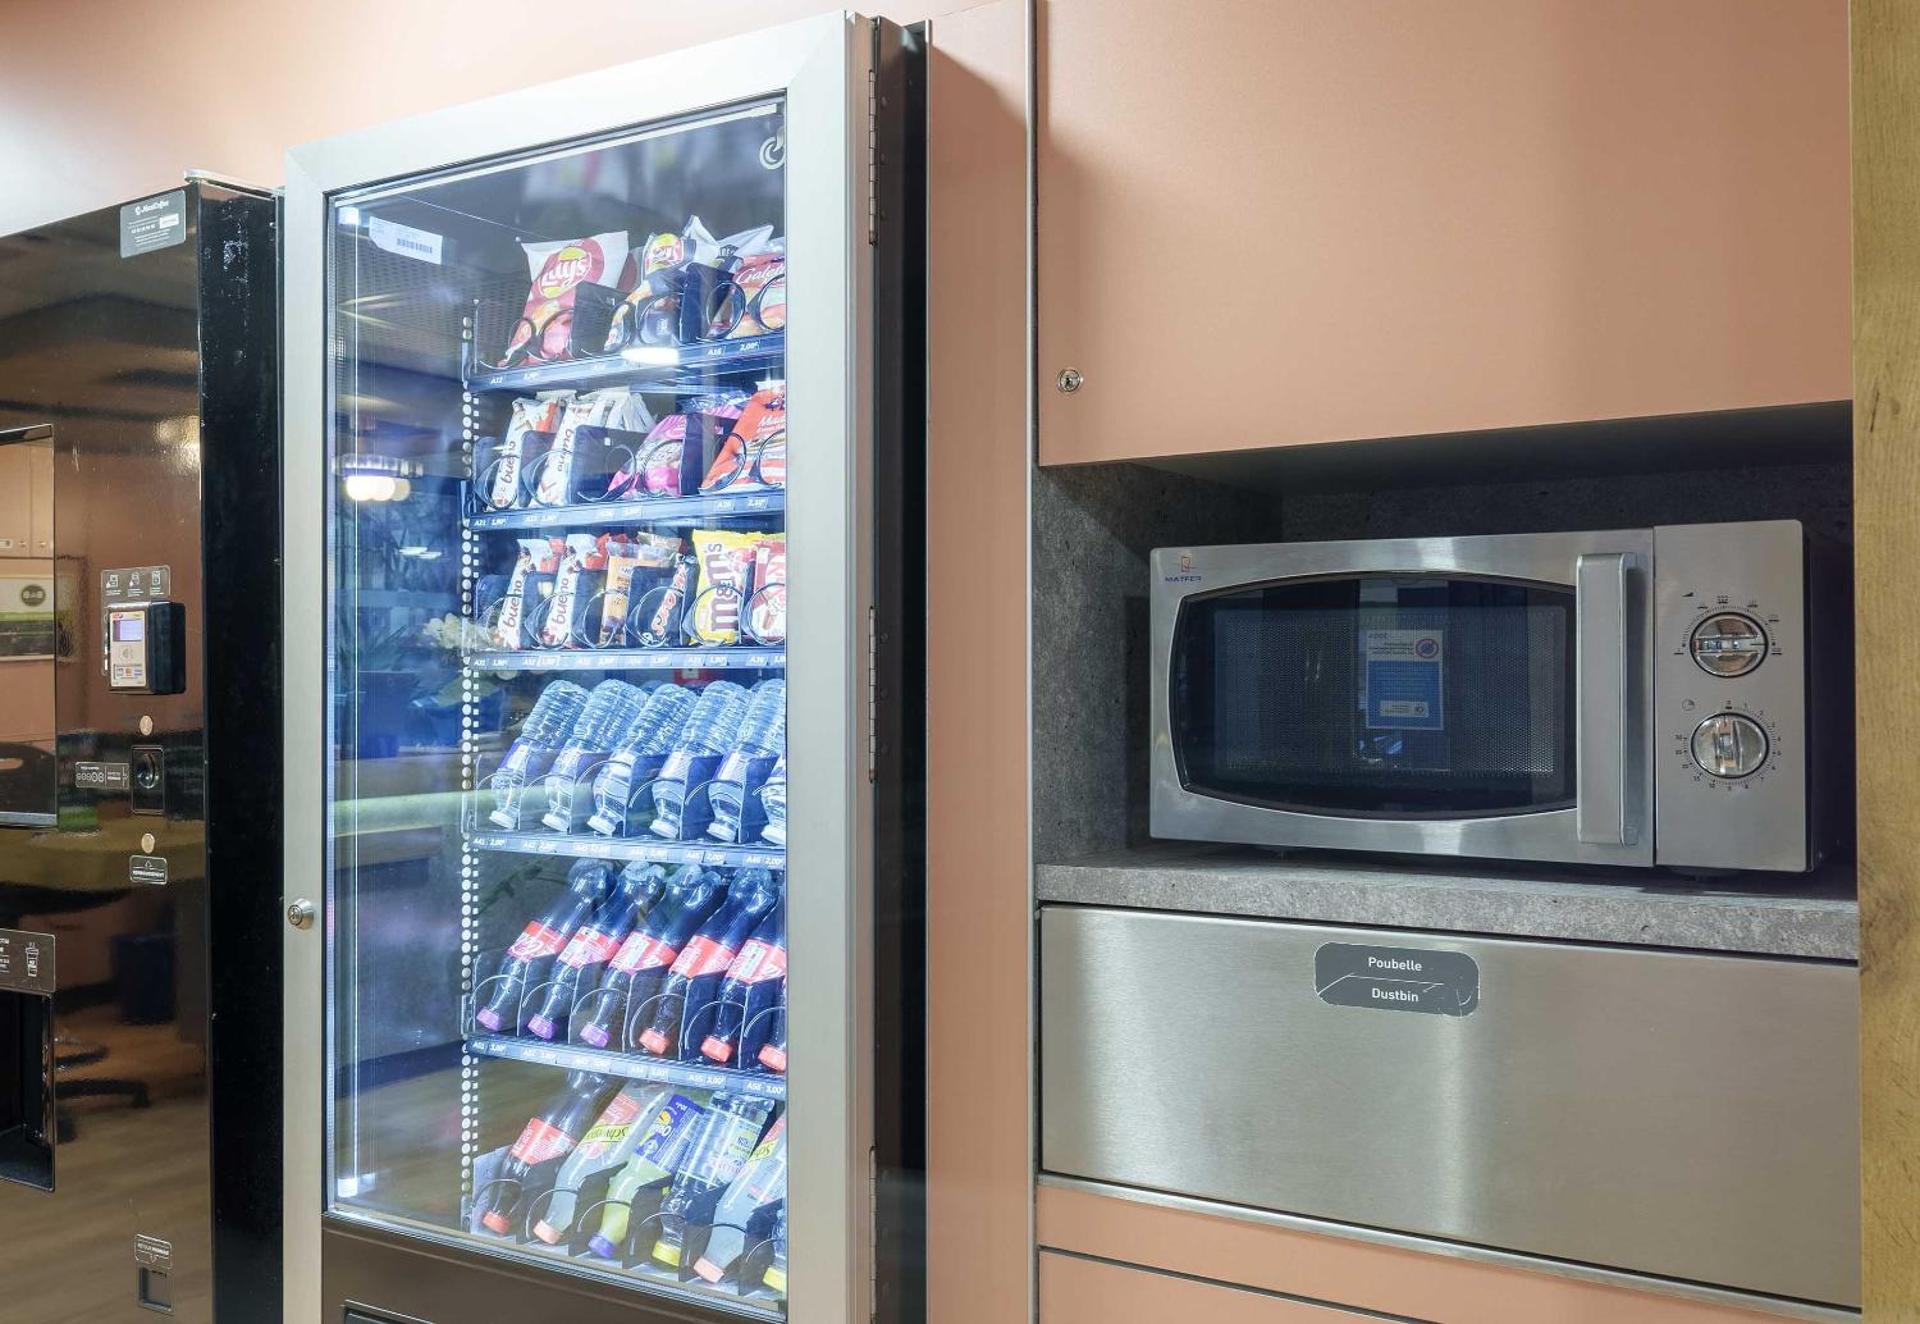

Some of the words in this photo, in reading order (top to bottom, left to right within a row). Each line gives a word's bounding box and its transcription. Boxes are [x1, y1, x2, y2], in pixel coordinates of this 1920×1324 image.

[502, 579, 523, 628] bueno
[552, 577, 570, 625] bueno
[1368, 957, 1423, 972] Poubelle
[1371, 988, 1419, 1003] Dustbin
